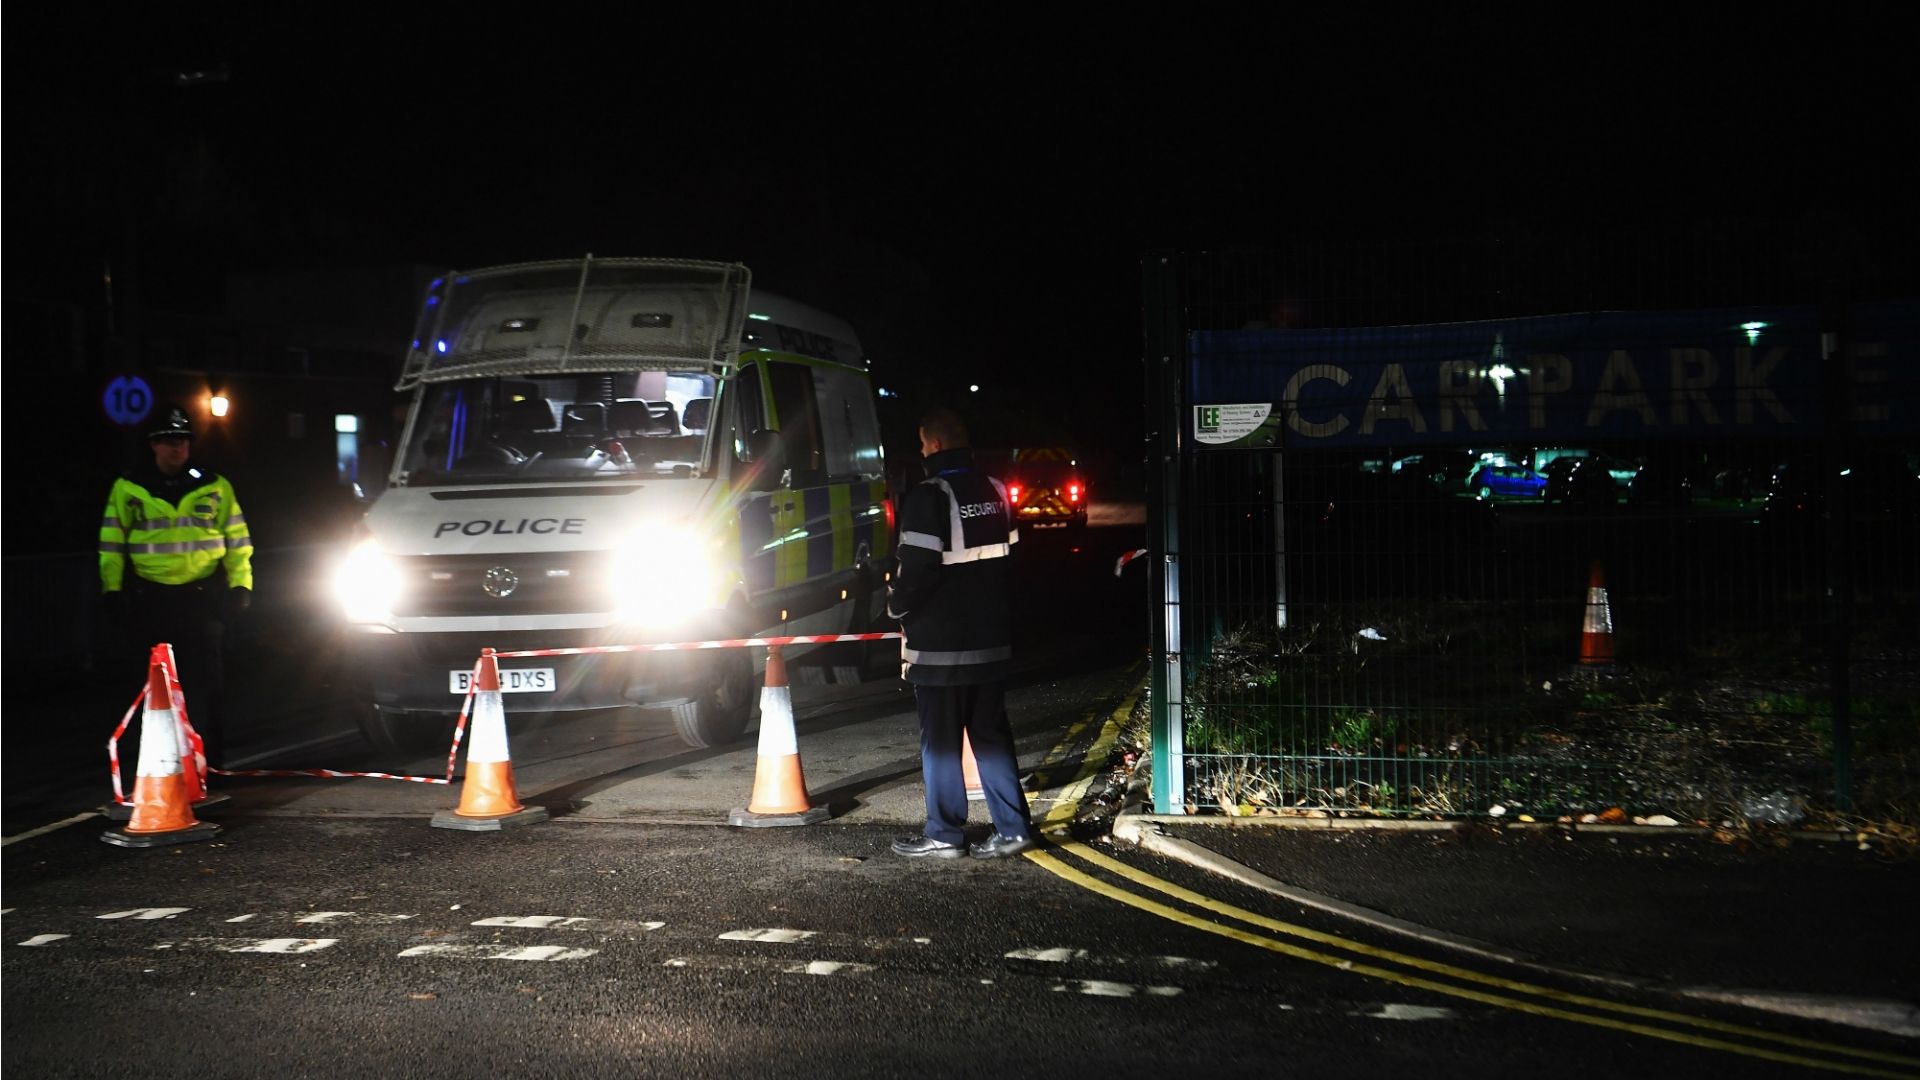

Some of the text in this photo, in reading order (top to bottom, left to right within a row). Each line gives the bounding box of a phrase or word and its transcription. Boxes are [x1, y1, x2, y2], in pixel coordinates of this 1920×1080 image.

[776, 323, 836, 359] POLICE
[113, 388, 147, 414] 10
[1281, 358, 1492, 438] CAR
[1528, 345, 1799, 430] PARK
[1198, 407, 1220, 430] LEE
[434, 518, 587, 539] POLICE
[510, 671, 547, 689] DXS
